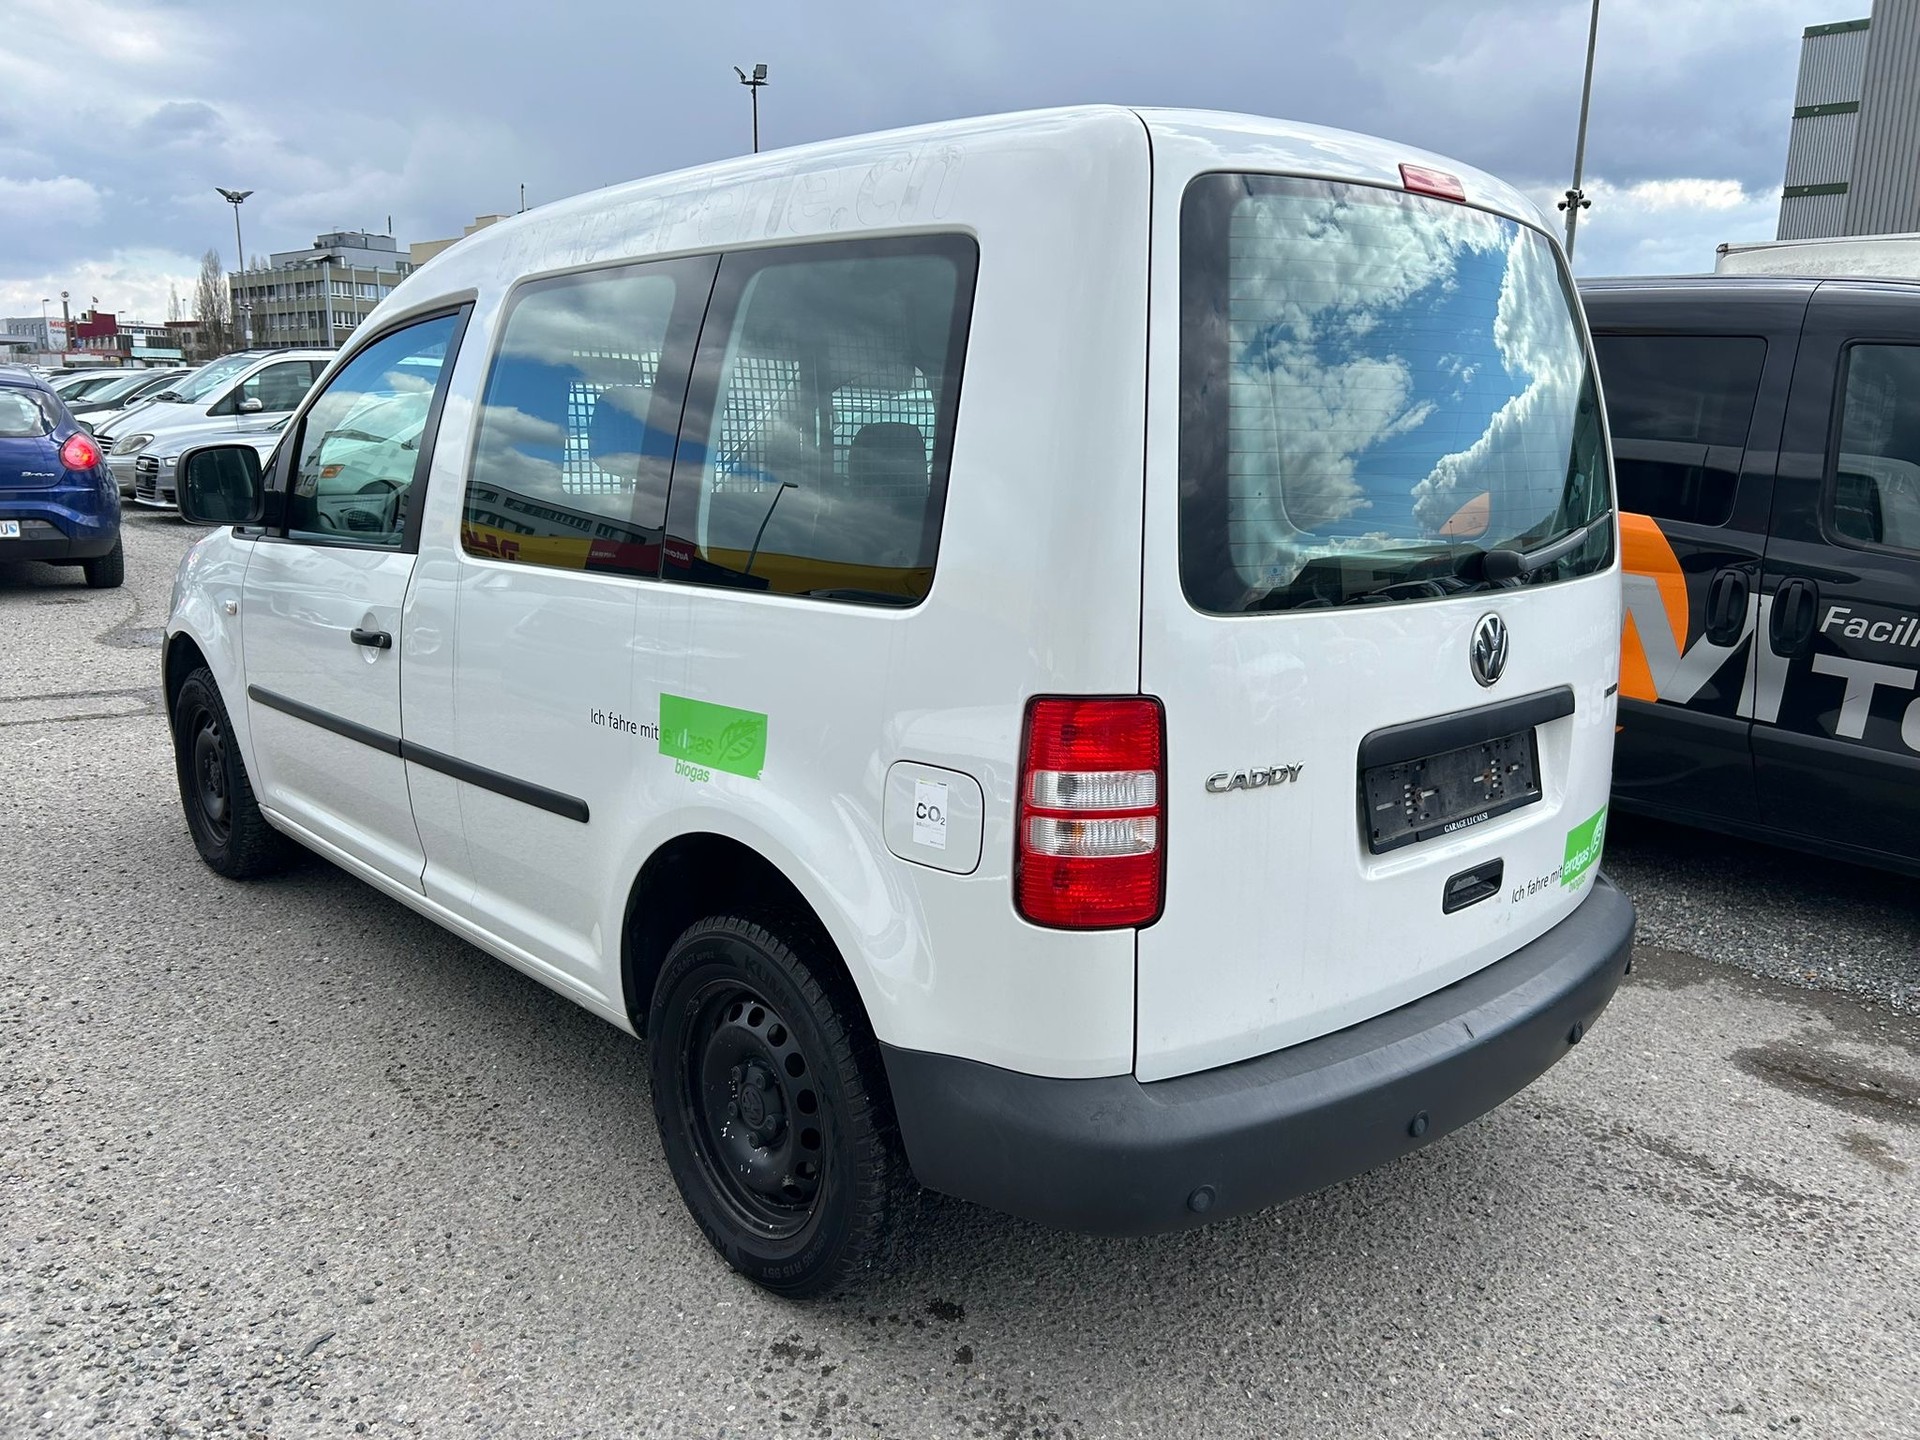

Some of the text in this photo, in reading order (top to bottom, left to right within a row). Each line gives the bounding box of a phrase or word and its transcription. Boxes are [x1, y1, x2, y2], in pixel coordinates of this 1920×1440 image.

[590, 708, 605, 726] Ich
[608, 711, 637, 735] fahre
[640, 722, 659, 741] mit
[675, 757, 710, 782] biogas
[1204, 761, 1306, 793] CADDY
[1444, 818, 1467, 833] GARAGE
[1511, 847, 1590, 903] Ich fahre mit erdgas
